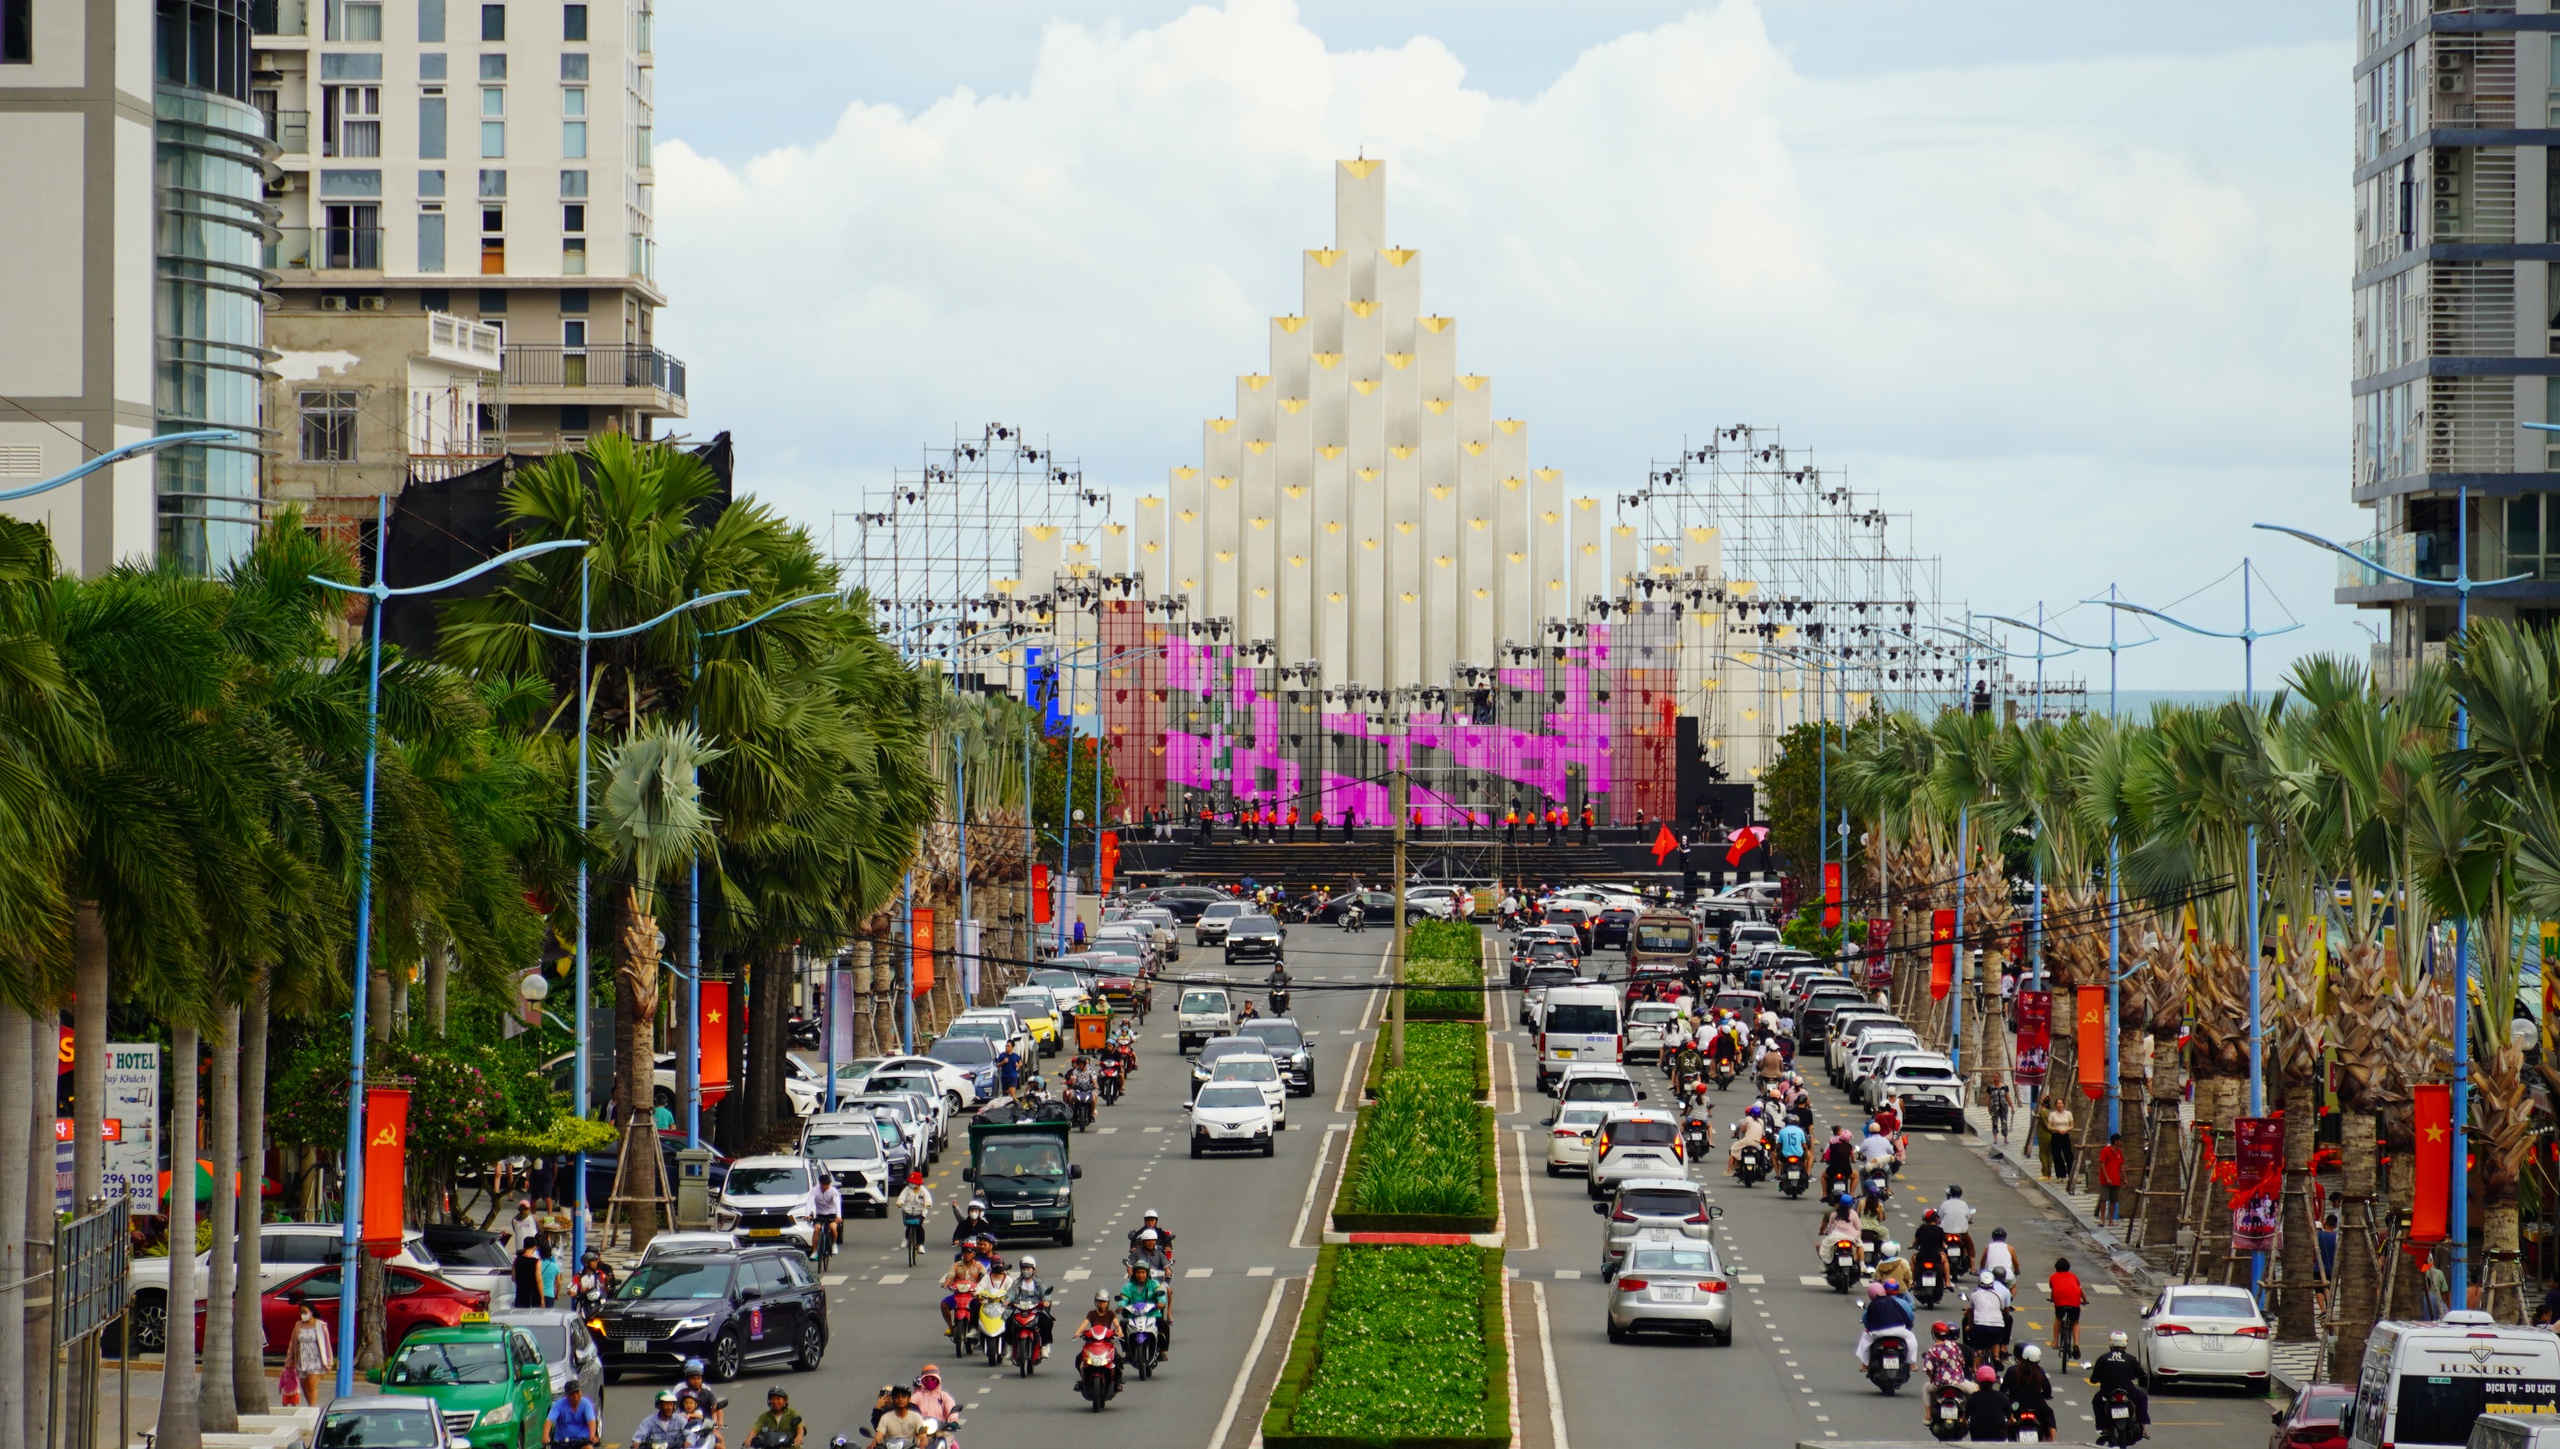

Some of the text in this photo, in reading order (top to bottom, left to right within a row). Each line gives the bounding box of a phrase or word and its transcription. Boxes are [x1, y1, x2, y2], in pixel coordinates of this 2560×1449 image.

[1197, 792, 1202, 802] 3
[1197, 804, 1202, 812] 2
[116, 1053, 156, 1070] HOTEL
[120, 1074, 146, 1084] Khách
[1788, 1132, 1796, 1146] 15
[102, 1174, 153, 1184] 296 109
[103, 1188, 153, 1198] 125 932
[2440, 1363, 2526, 1376] LUXURY
[2485, 1383, 2505, 1394] DỊCH
[2507, 1383, 2517, 1394] VỤ
[2525, 1384, 2536, 1393] DU
[2537, 1384, 2556, 1395] LỊCH
